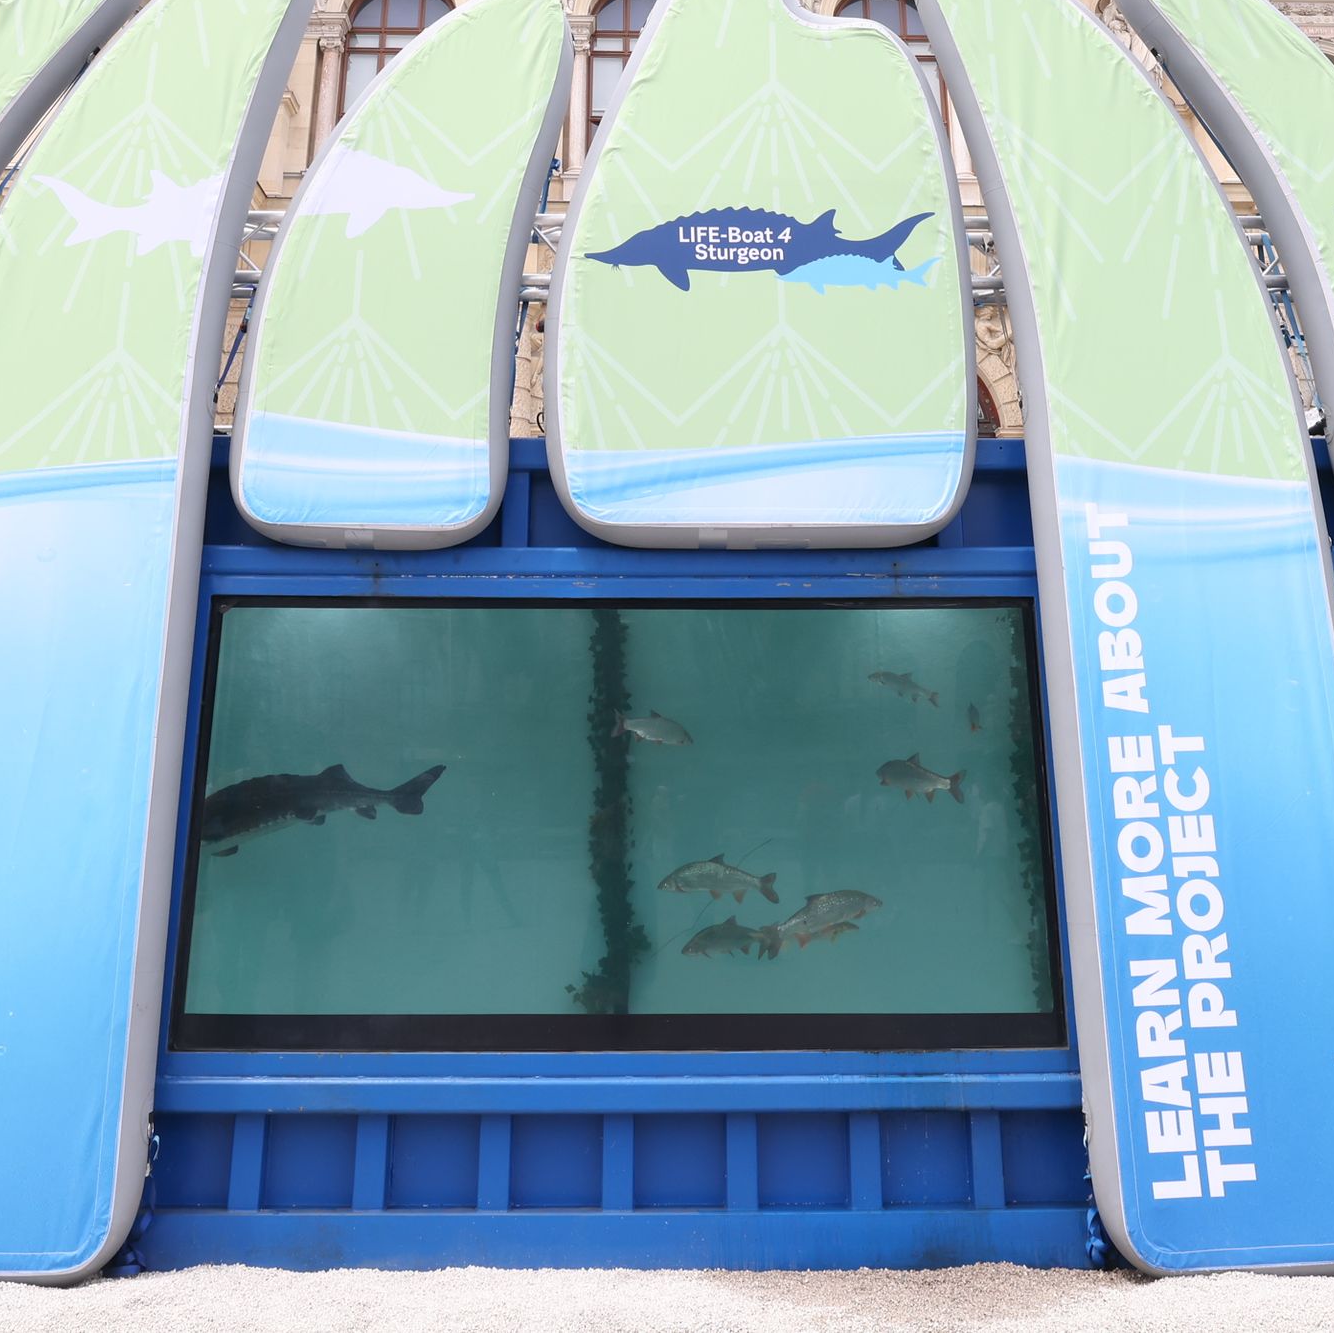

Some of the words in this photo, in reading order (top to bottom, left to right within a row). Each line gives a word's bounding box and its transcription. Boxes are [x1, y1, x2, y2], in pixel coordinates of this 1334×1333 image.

[678, 226, 774, 244] LIFE-Boat
[777, 226, 792, 243] 4
[694, 244, 784, 265] Sturgeon
[1083, 501, 1150, 715] ABOUT
[1107, 734, 1174, 937] MORE
[1158, 724, 1239, 1029] PROJECT
[1130, 958, 1203, 1200] LEARN
[1190, 1050, 1258, 1198] THE
